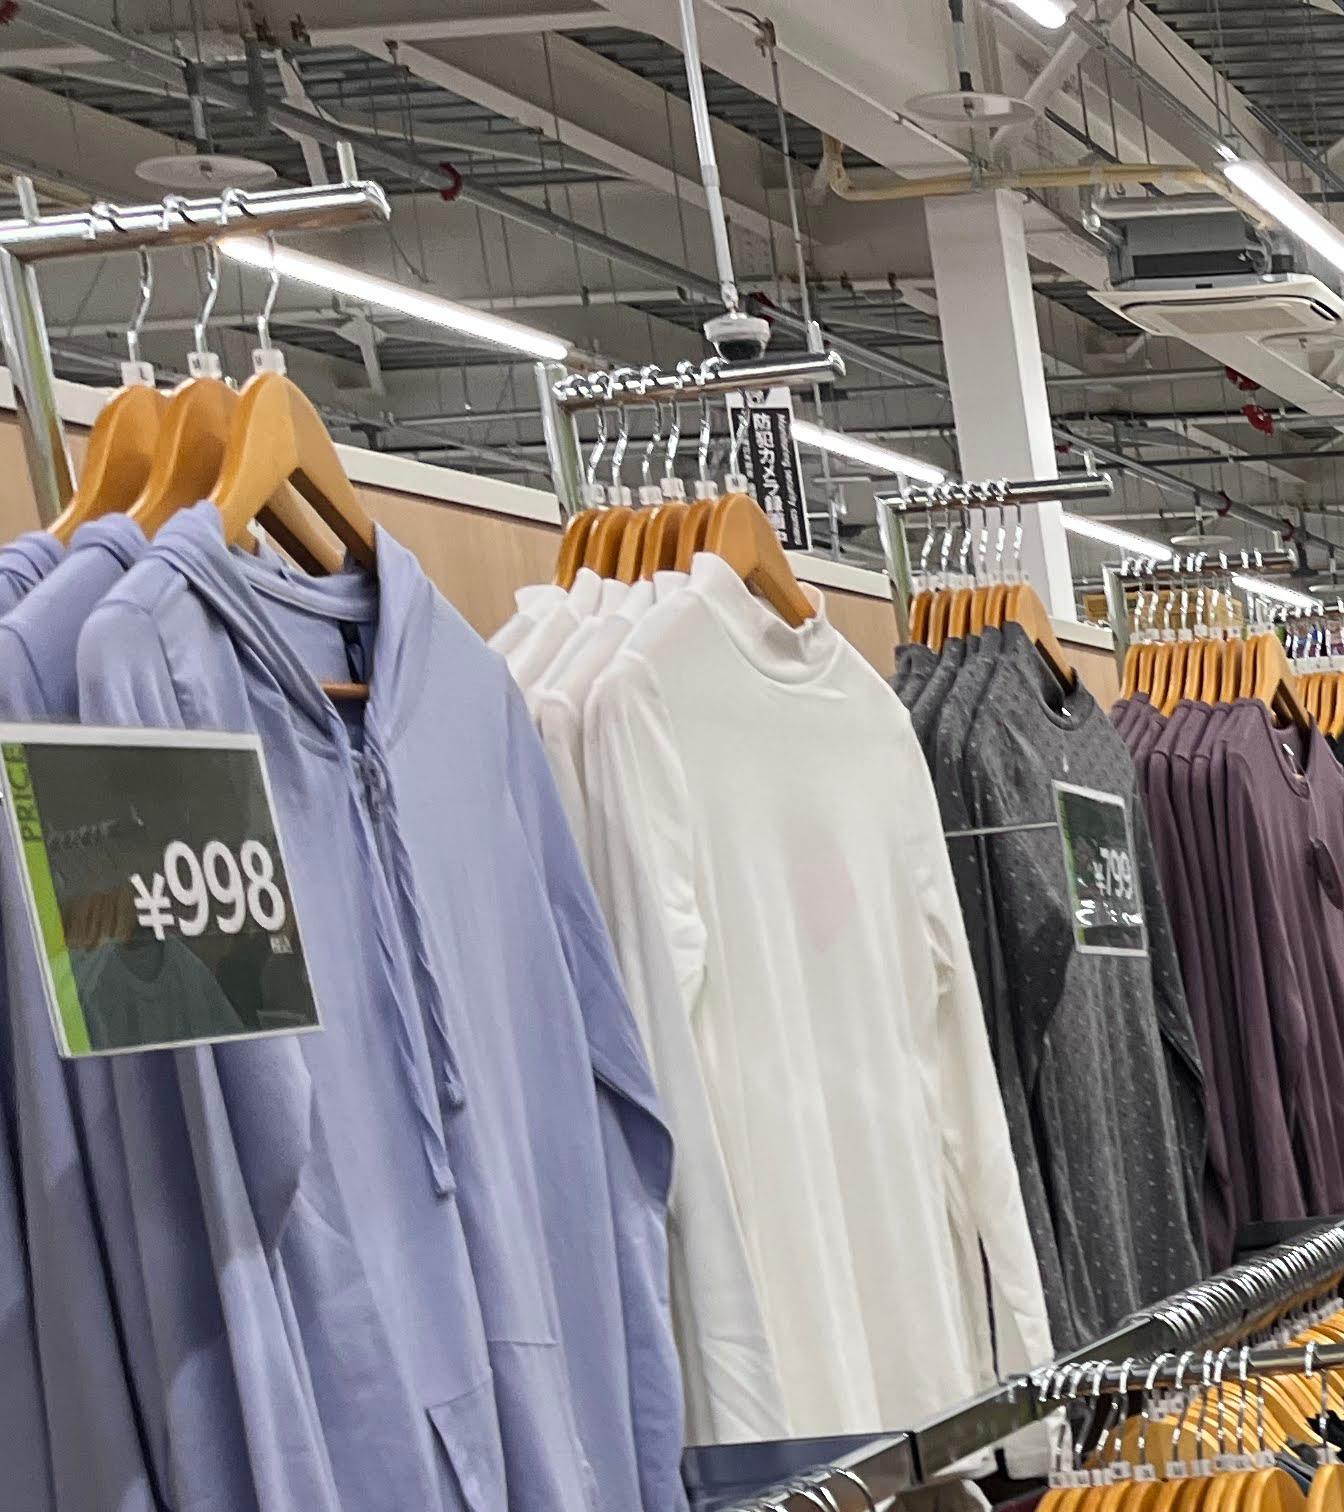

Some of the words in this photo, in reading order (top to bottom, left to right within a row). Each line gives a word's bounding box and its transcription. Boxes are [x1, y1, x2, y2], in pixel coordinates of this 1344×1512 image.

[5, 744, 42, 842] PRICE
[128, 839, 286, 941] ¥998
[1091, 846, 1134, 900] ¥799
